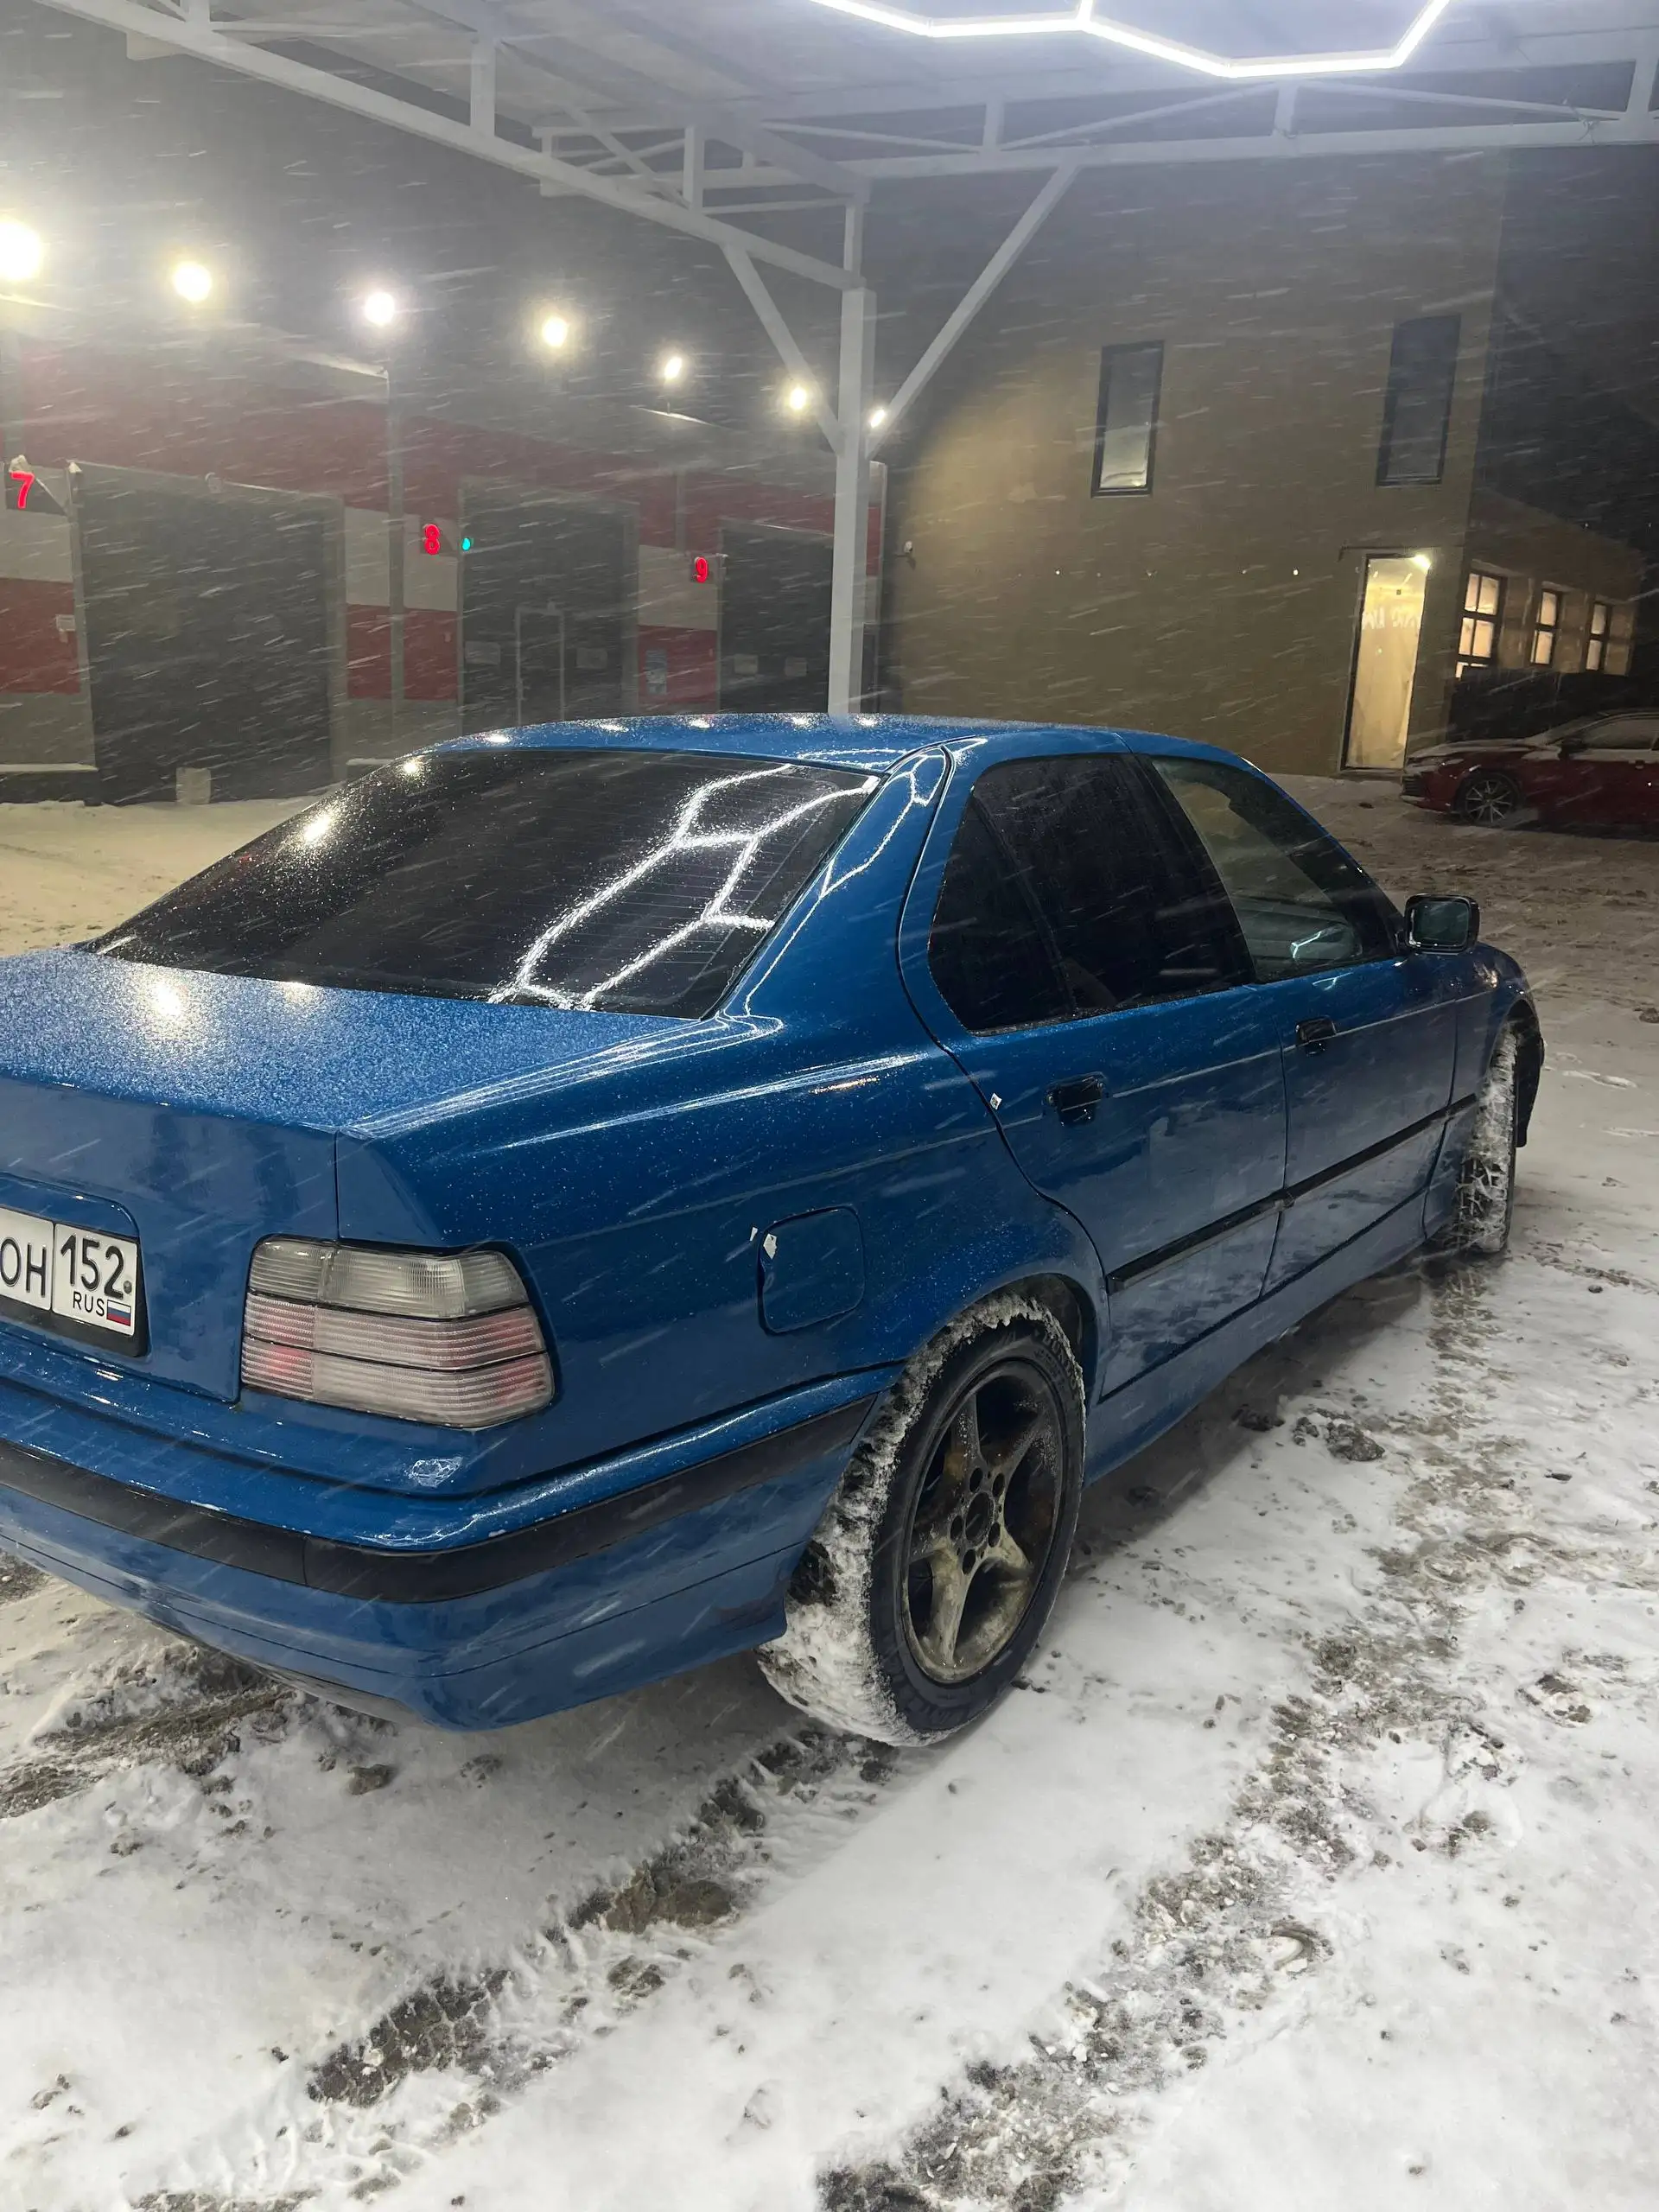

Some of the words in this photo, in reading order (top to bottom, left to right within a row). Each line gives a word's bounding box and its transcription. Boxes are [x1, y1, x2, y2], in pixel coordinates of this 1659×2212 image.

[10, 471, 35, 510] 7
[424, 524, 441, 556] 8
[695, 556, 709, 583] 9
[60, 1233, 124, 1300] 152
[73, 1291, 105, 1317] RUS
[1041, 1330, 1078, 1399] DUNLO
